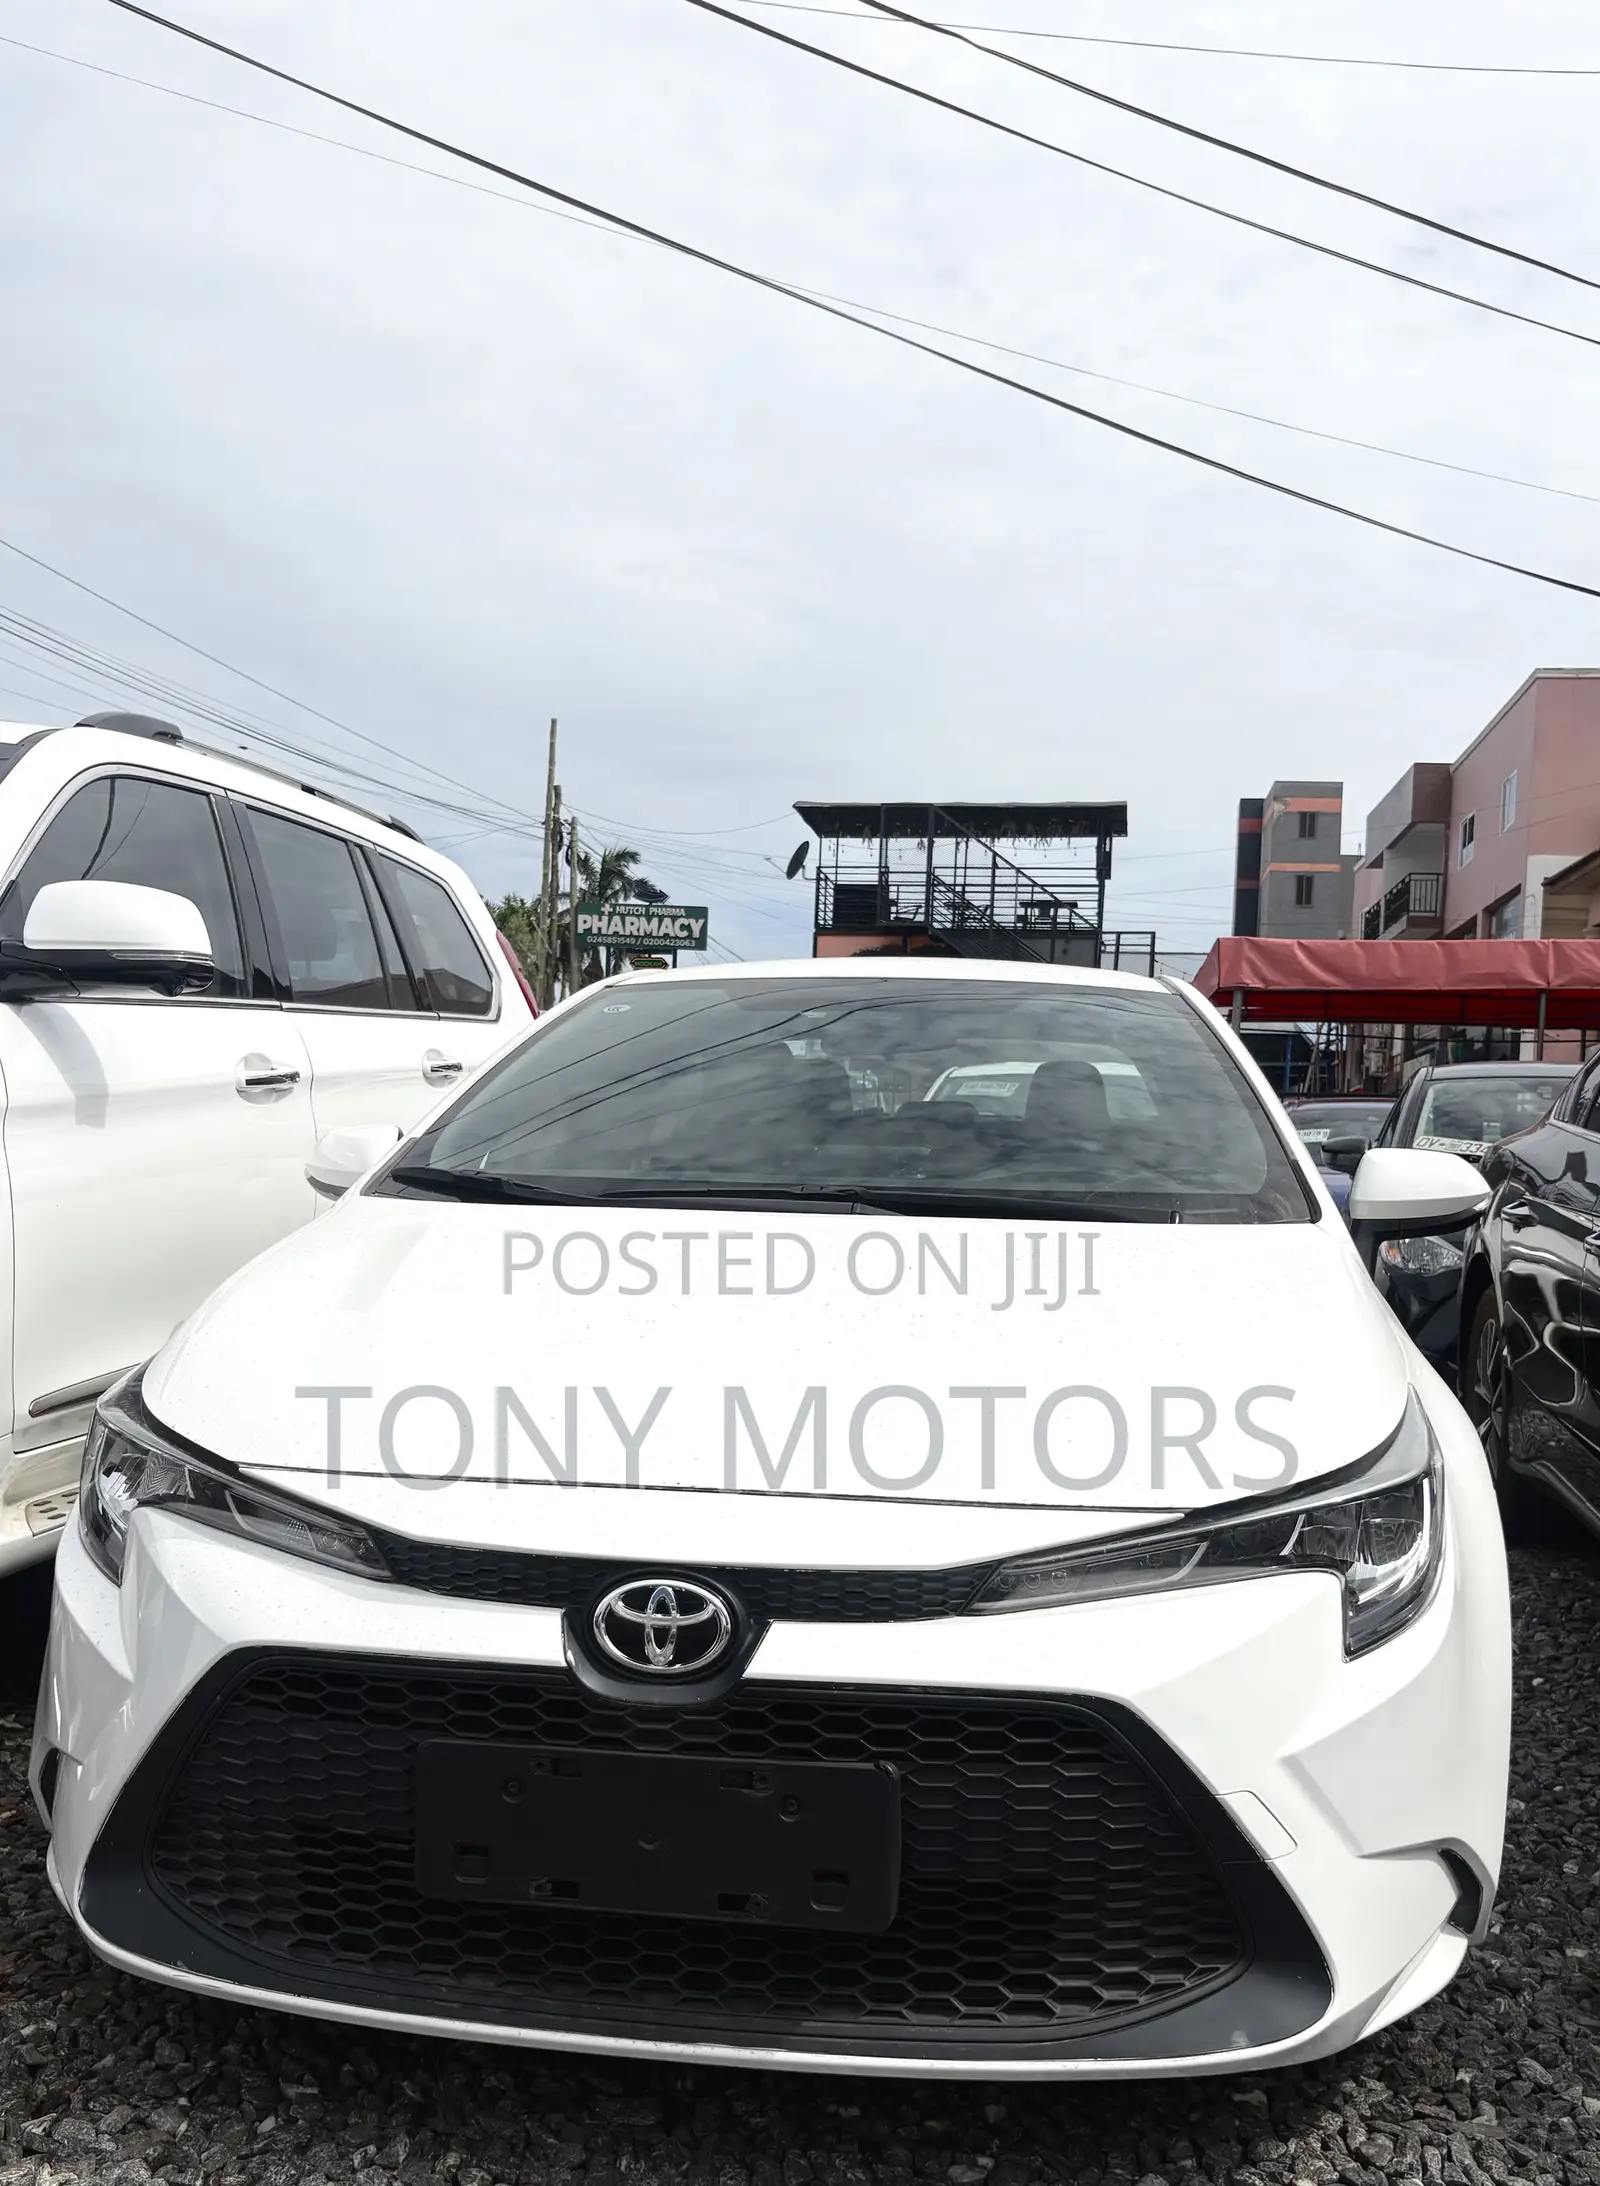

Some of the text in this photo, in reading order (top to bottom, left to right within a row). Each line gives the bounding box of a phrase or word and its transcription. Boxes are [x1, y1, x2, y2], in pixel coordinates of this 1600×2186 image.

[616, 905, 686, 917] HUTCH PHARMA
[577, 914, 705, 938] PHARMACY
[643, 938, 696, 947] 0200423063
